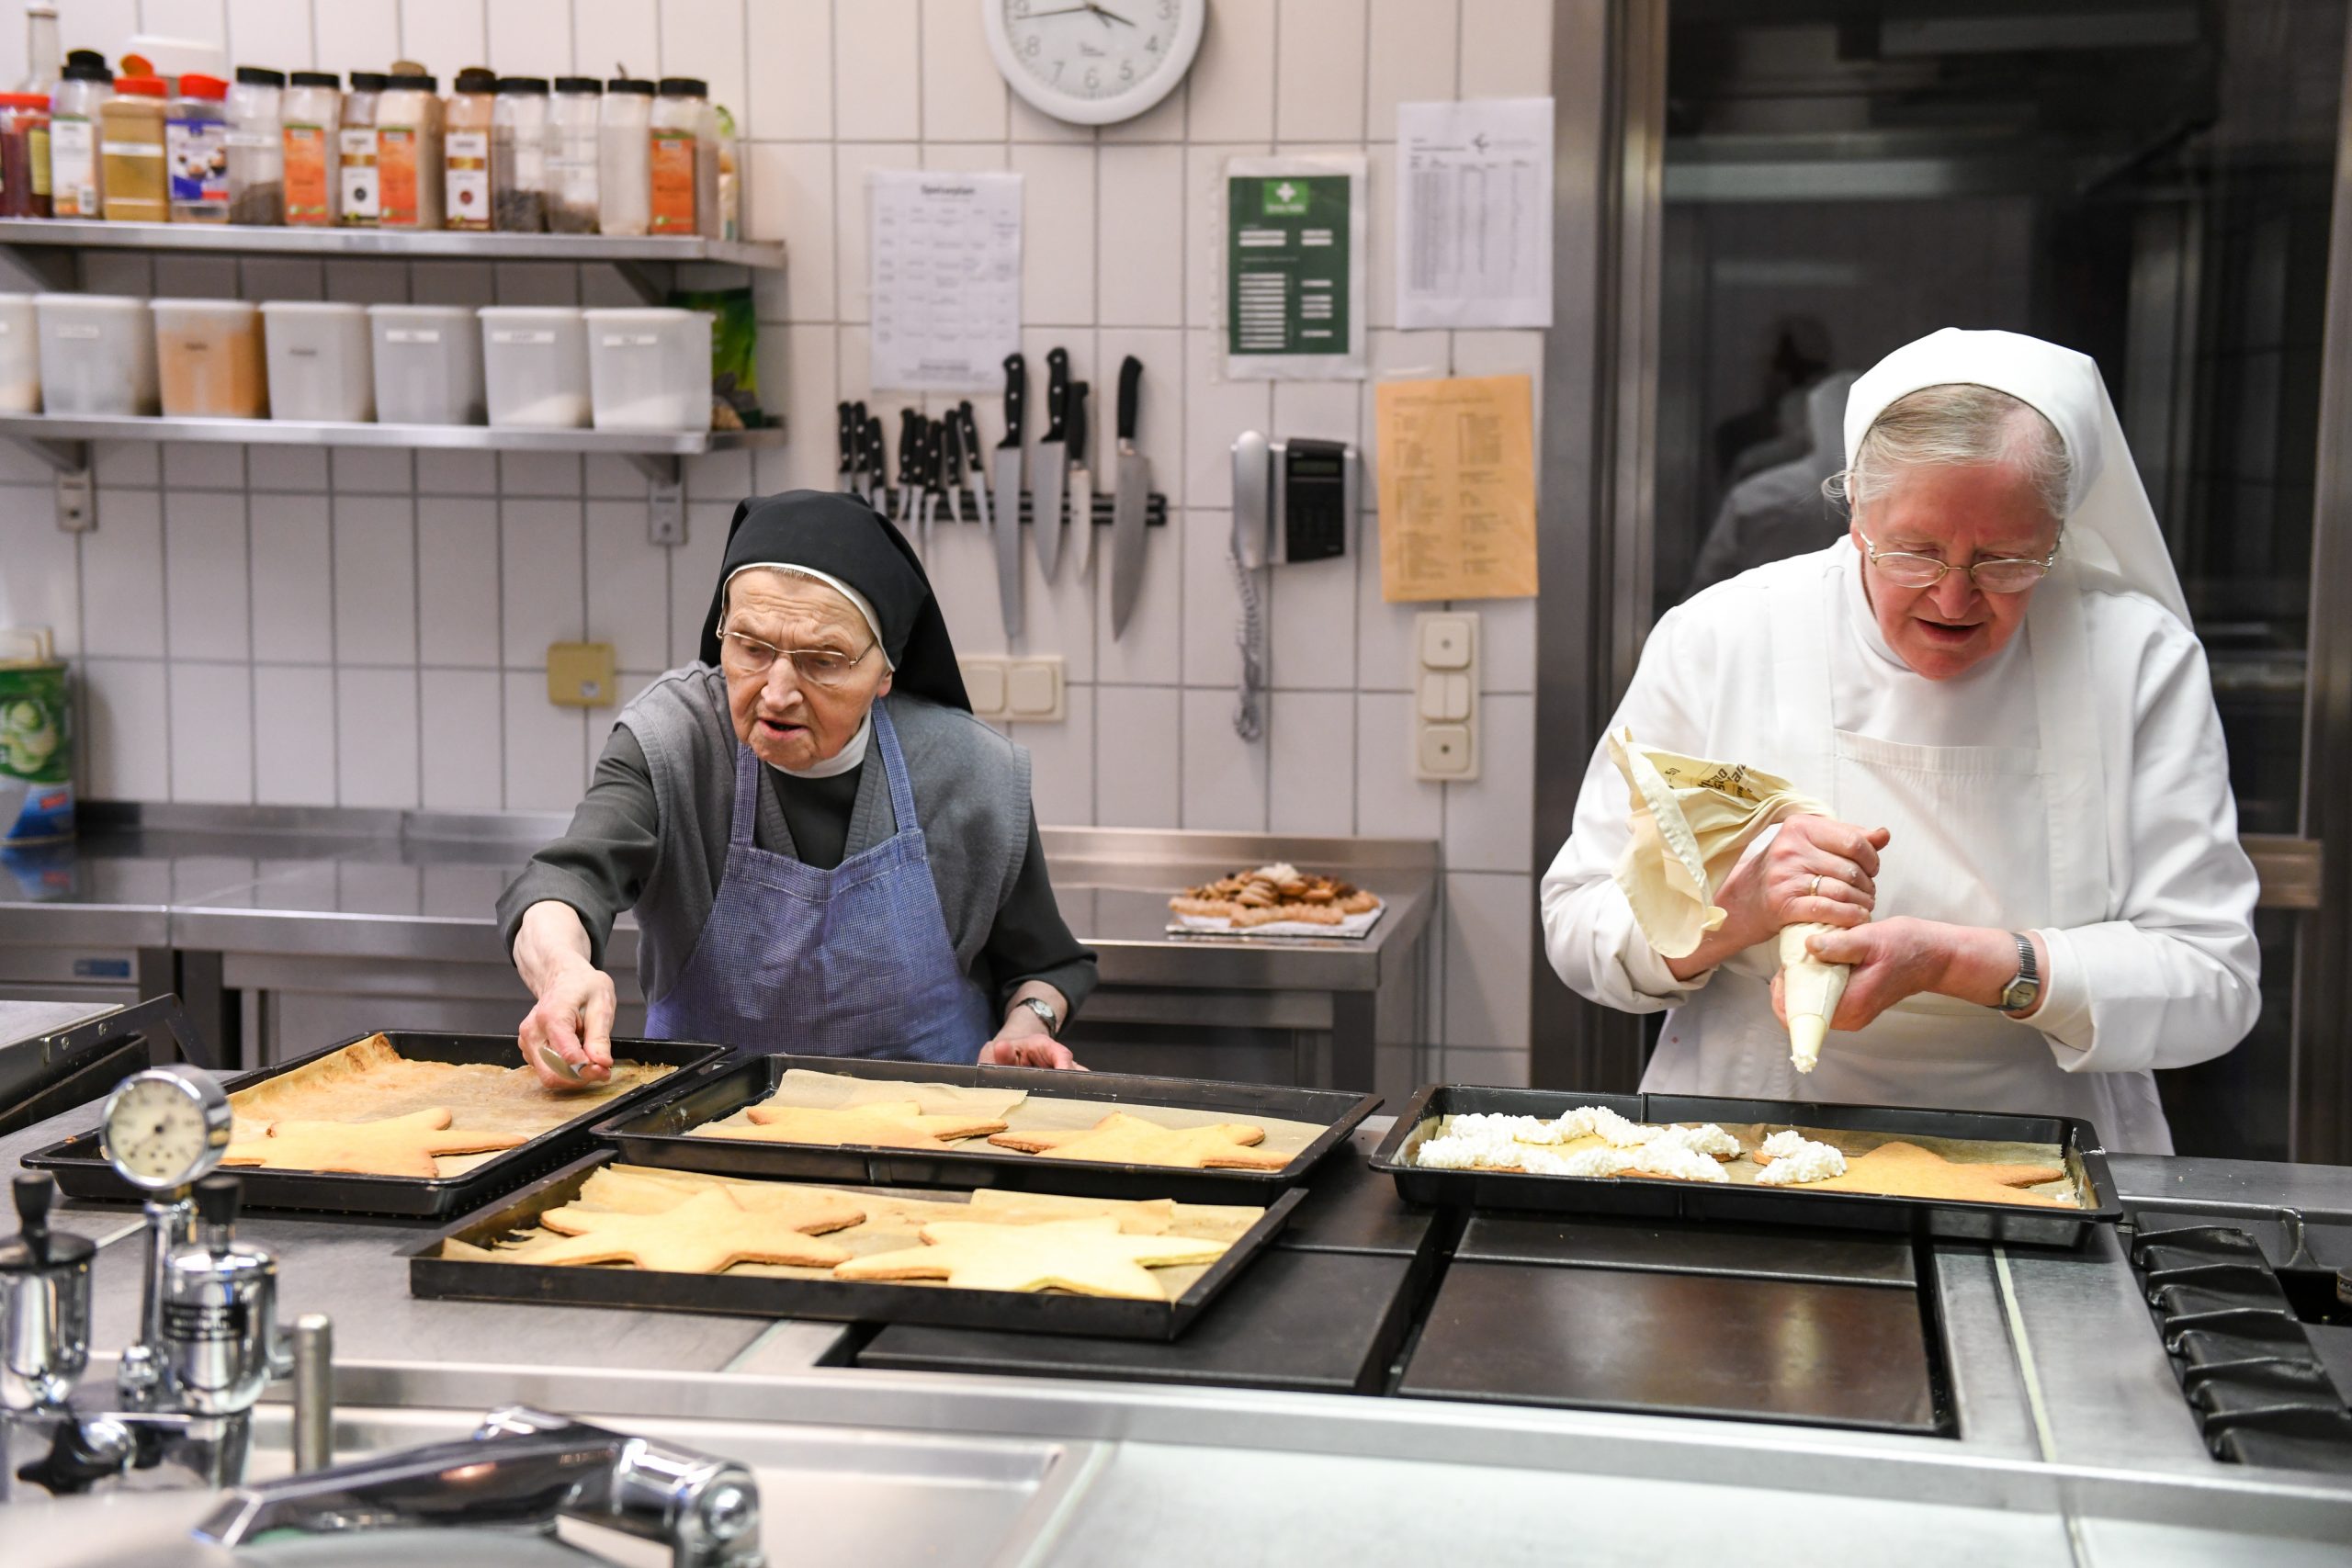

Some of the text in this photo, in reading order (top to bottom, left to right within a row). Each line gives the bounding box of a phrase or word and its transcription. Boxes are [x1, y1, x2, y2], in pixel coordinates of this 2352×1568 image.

[1157, 0, 1171, 20] 3
[1024, 35, 1041, 57] 8
[1144, 35, 1159, 53] 4
[1051, 61, 1065, 84] 7
[1084, 66, 1101, 90] 6
[1120, 60, 1134, 81] 5
